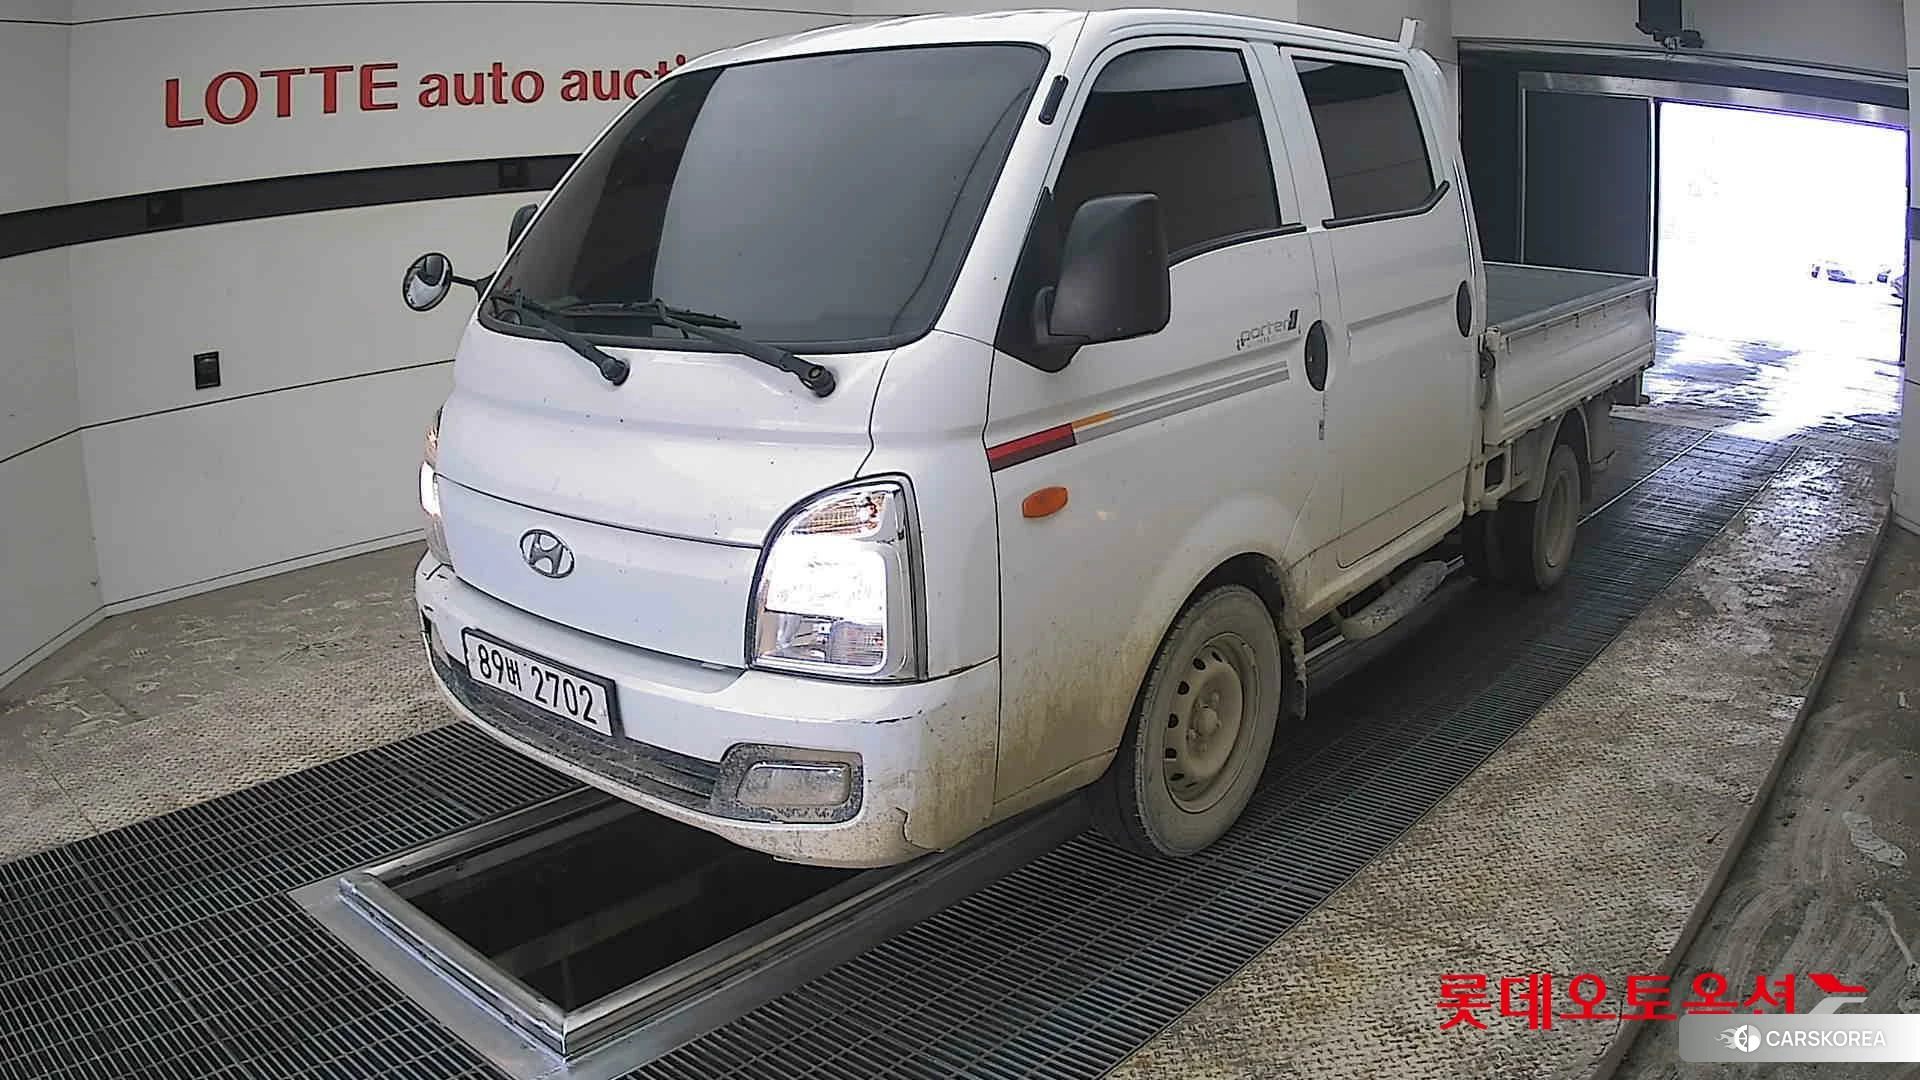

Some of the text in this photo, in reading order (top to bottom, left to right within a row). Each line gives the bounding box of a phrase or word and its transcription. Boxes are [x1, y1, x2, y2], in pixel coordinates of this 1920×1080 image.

[165, 63, 399, 128] LOTTE
[418, 61, 545, 108] auto
[531, 665, 598, 725] 2702
